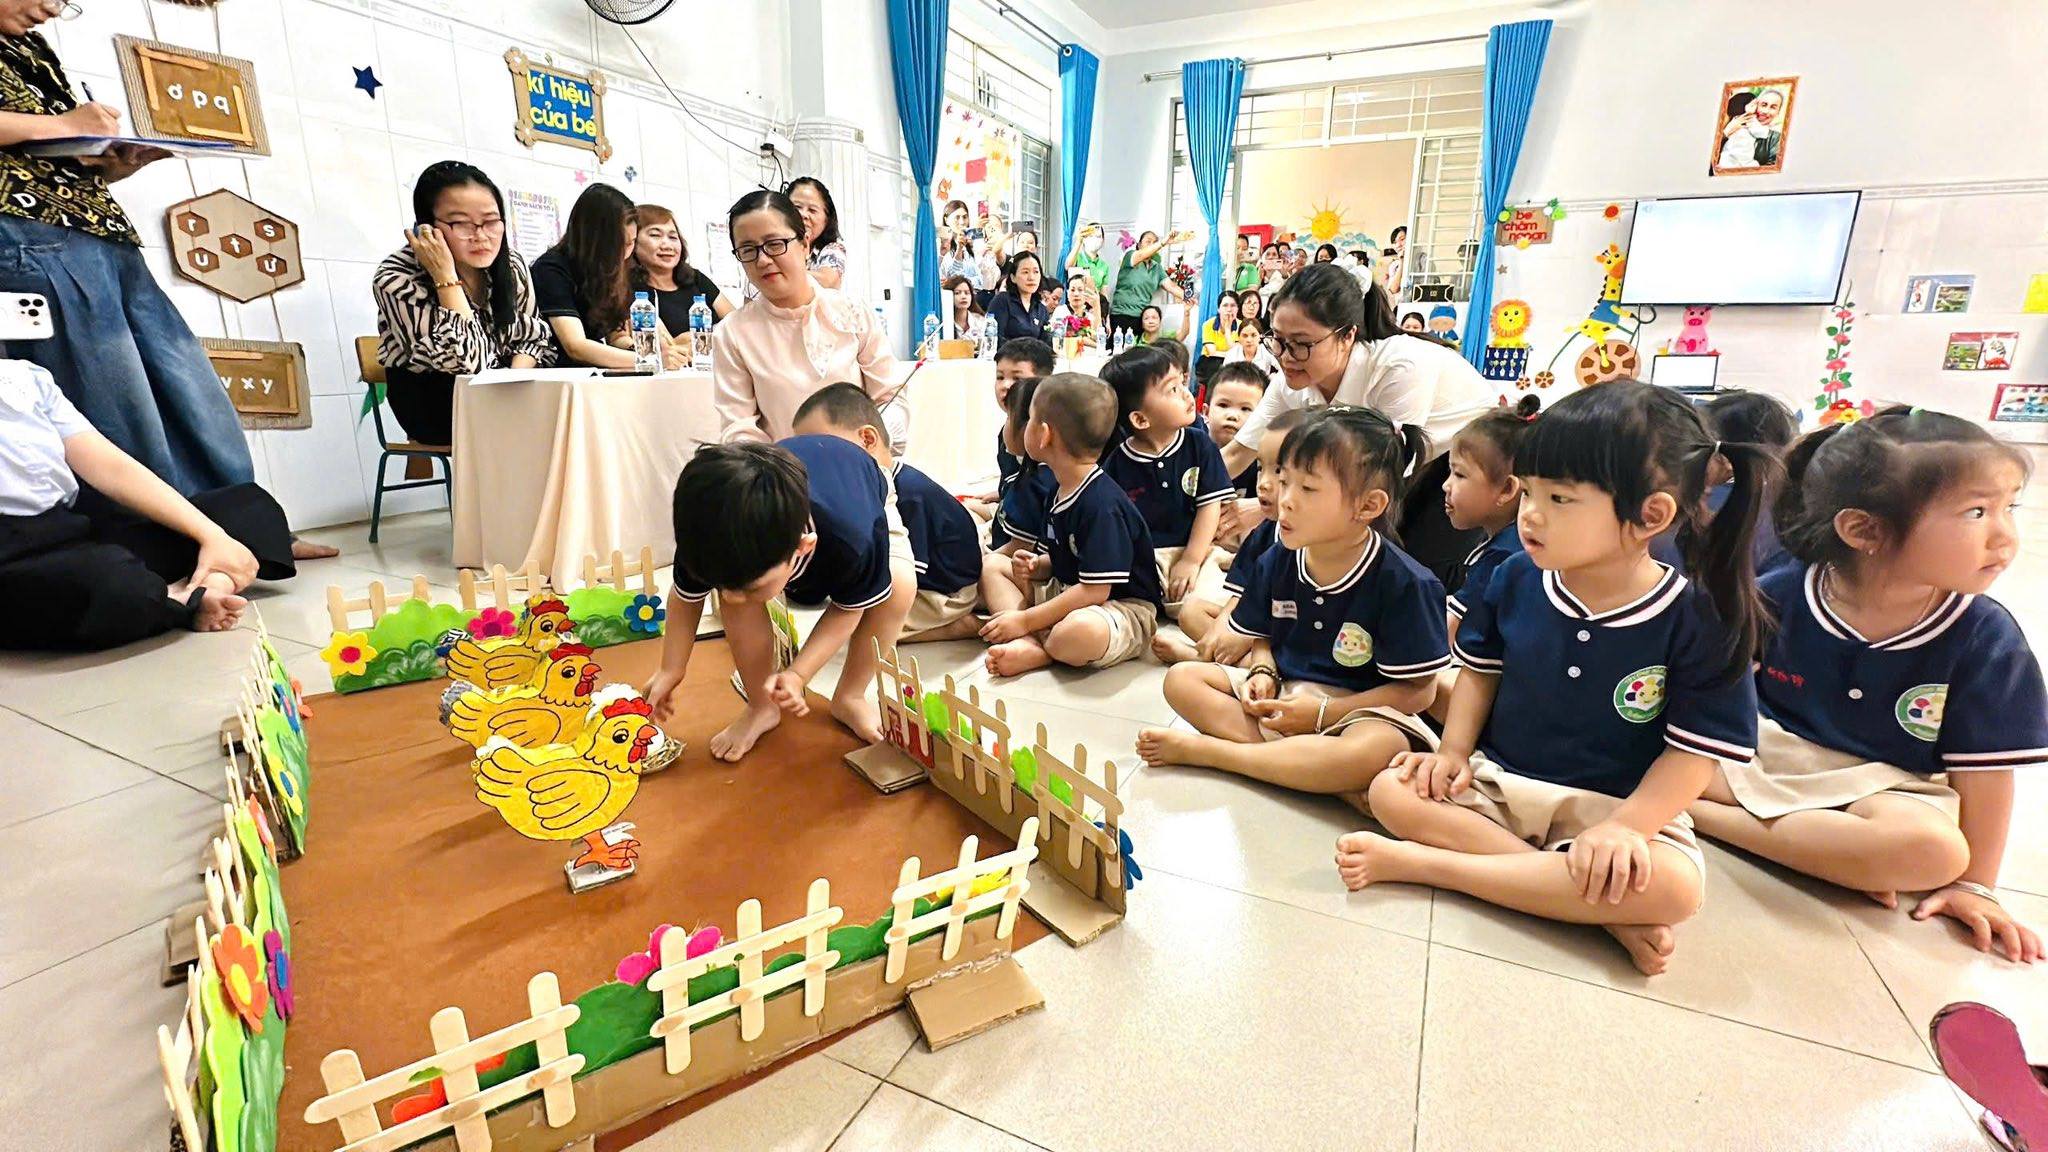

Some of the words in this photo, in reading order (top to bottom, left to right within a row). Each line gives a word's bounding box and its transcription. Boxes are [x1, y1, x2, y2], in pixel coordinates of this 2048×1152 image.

[526, 68, 545, 95] kí
[549, 76, 591, 109] hiệu
[191, 90, 208, 109] p
[213, 95, 231, 116] q
[530, 100, 568, 130] của
[571, 111, 597, 137] bé
[187, 218, 197, 232] r
[262, 224, 276, 238] s
[230, 237, 241, 254] t
[195, 252, 209, 267] u
[241, 377, 255, 390] x
[261, 378, 273, 395] y
